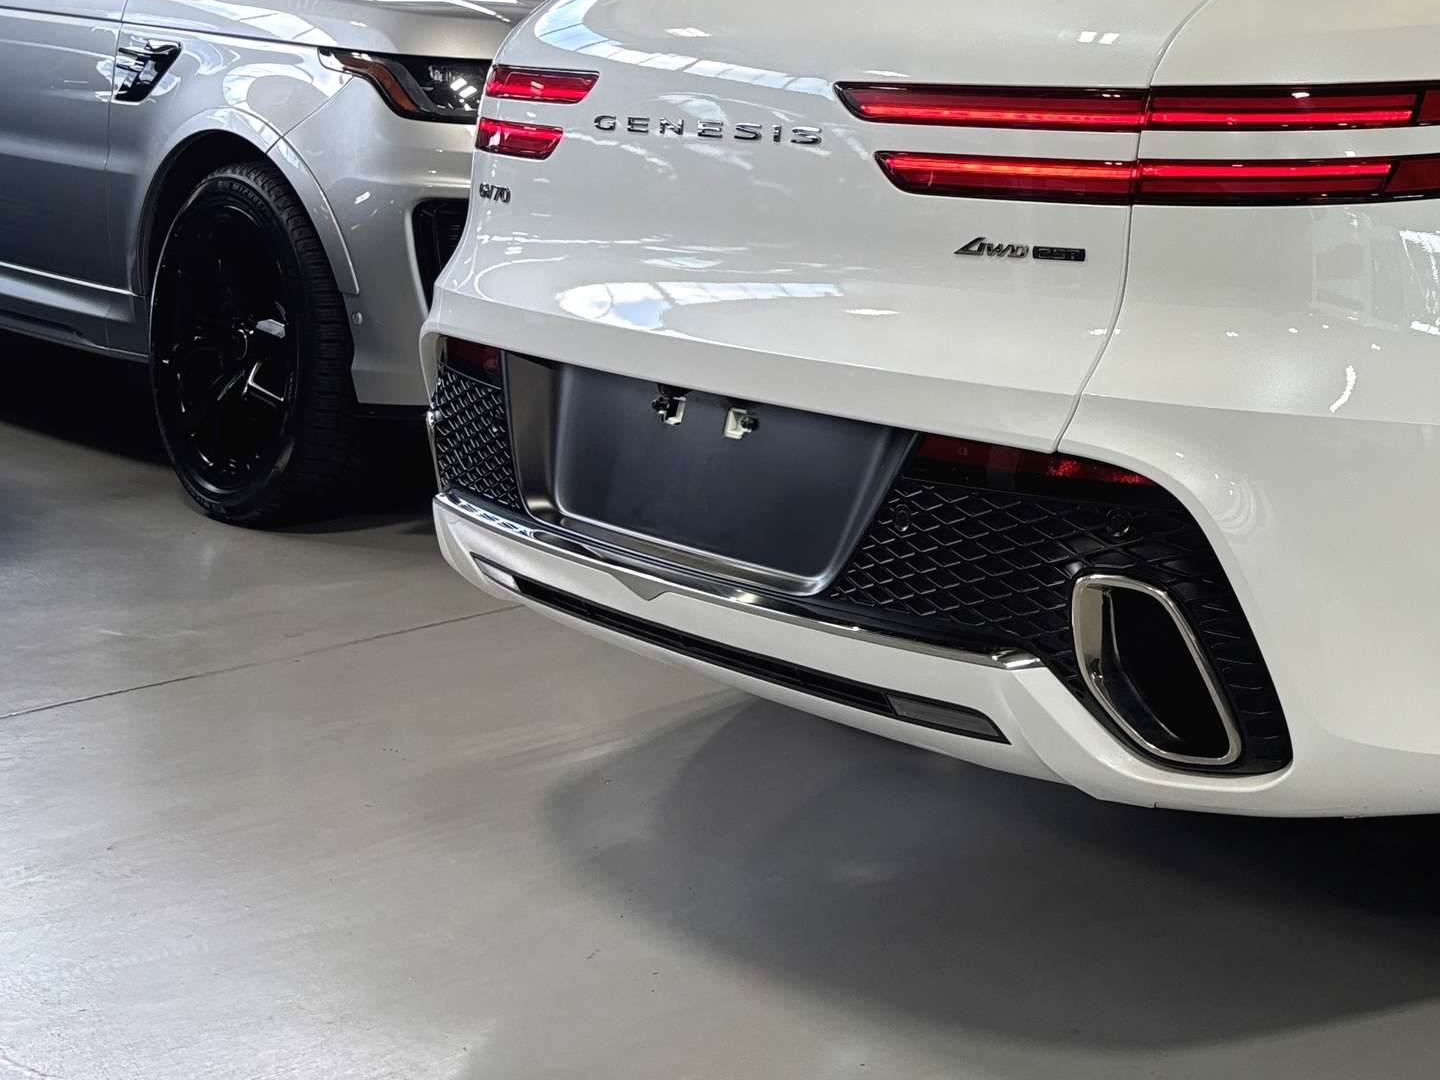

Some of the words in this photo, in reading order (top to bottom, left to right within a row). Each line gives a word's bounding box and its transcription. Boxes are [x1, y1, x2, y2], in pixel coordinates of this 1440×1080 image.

[593, 114, 822, 146] GENESIS
[479, 182, 511, 203] GV70
[953, 236, 1029, 258] AWD
